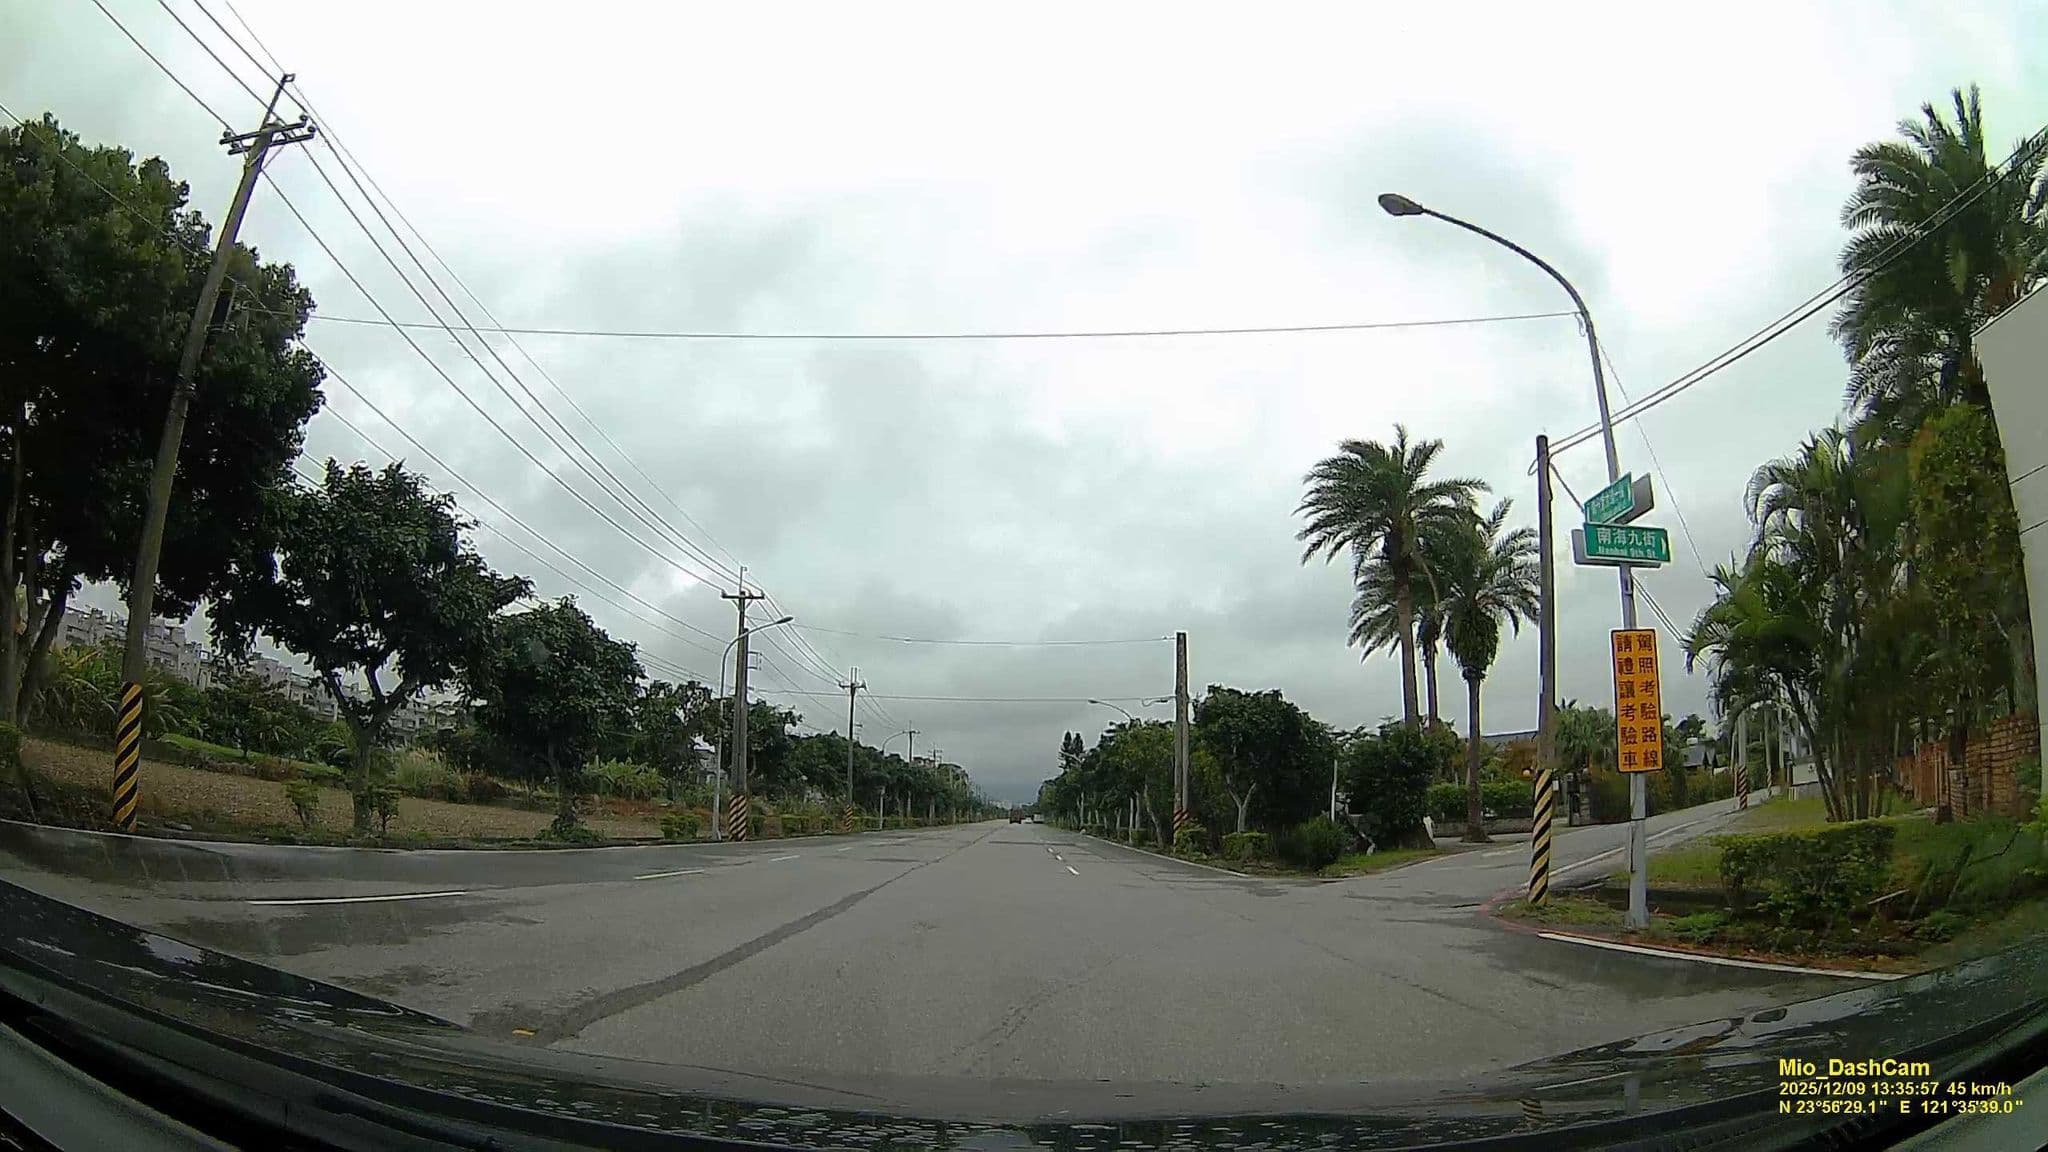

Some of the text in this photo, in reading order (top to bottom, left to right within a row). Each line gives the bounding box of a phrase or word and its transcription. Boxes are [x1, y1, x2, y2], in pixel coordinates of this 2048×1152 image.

[1596, 527, 1656, 547] 南海九街
[1616, 633, 1638, 769] 請禮讓考驗車
[1636, 633, 1658, 768] 駕照考驗路線
